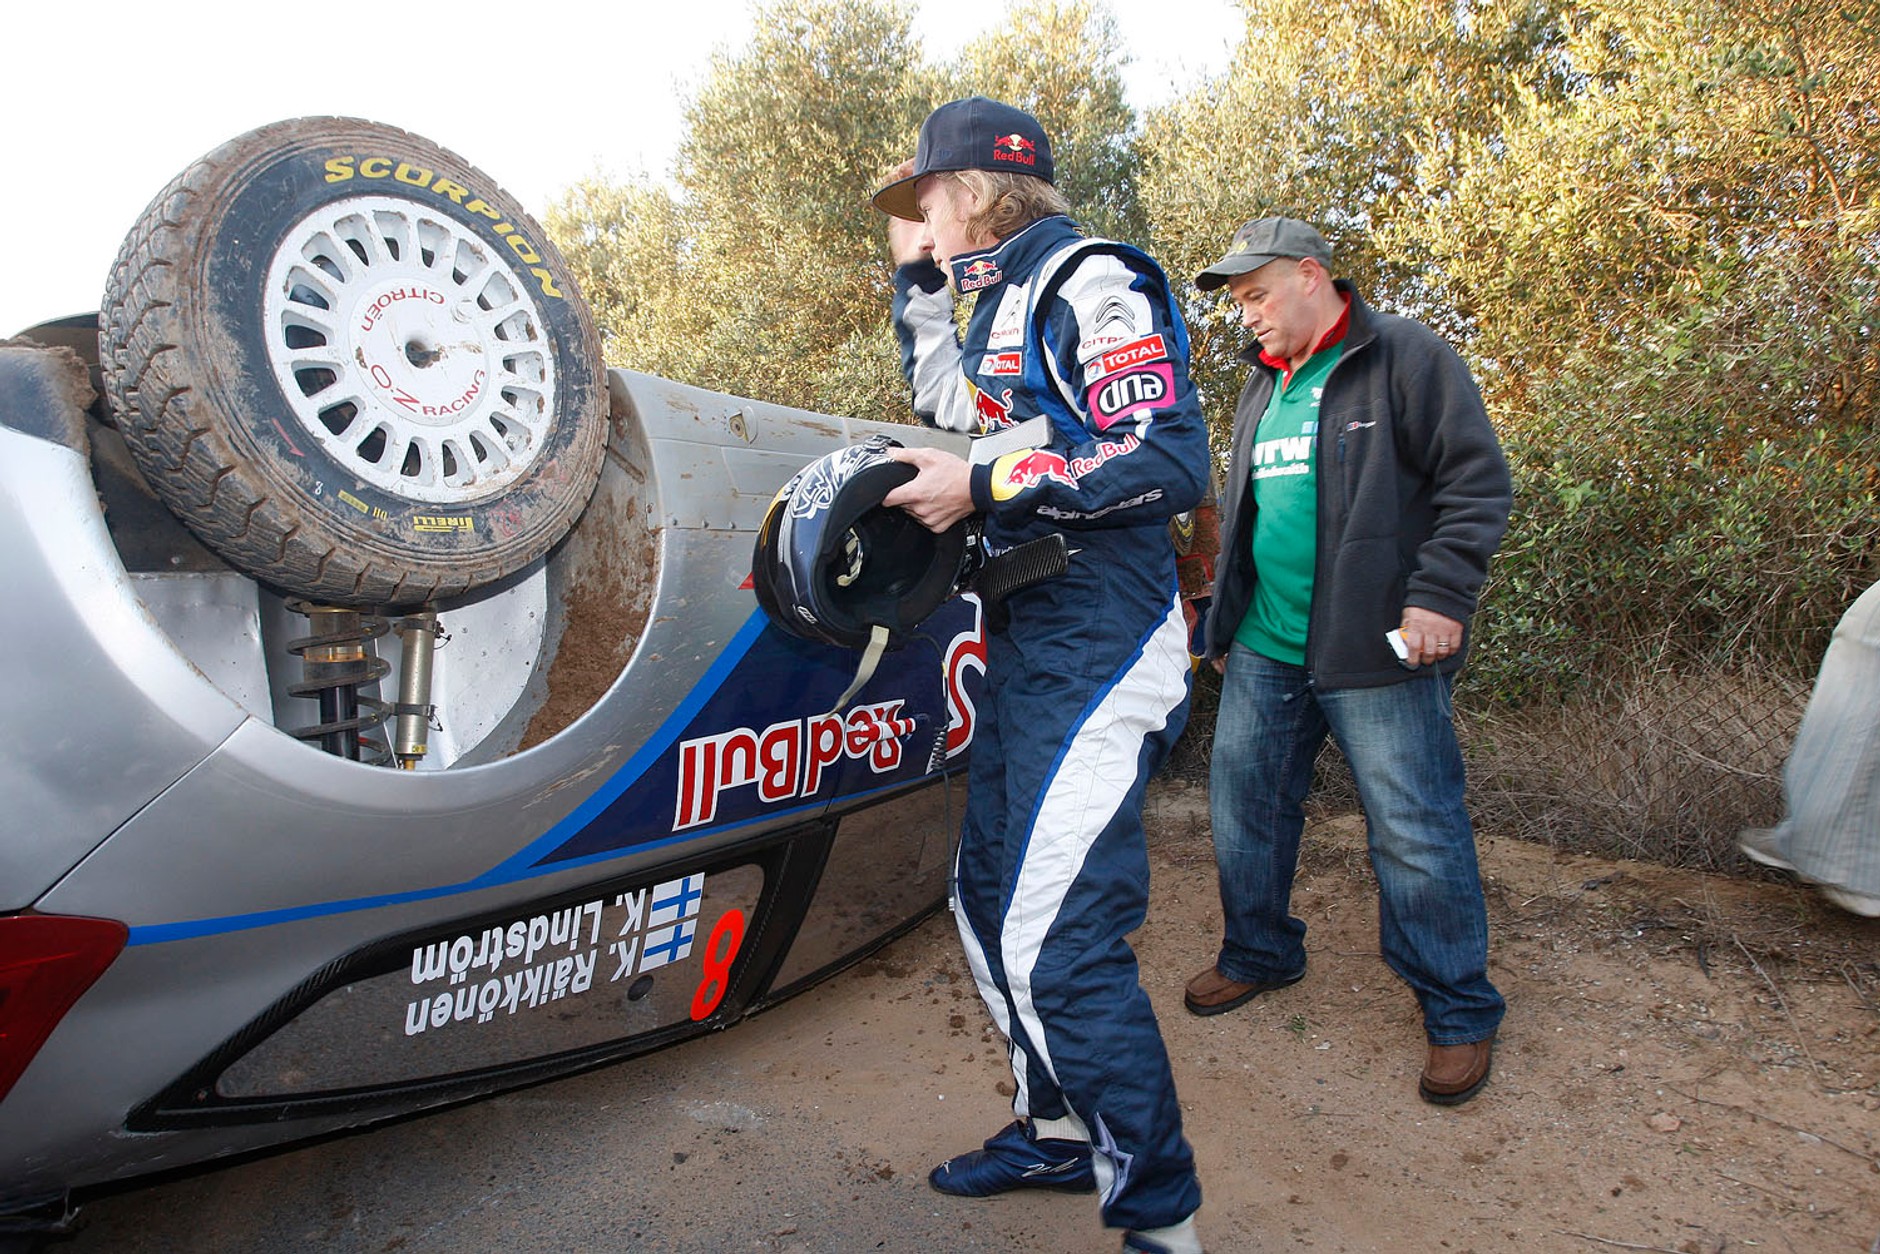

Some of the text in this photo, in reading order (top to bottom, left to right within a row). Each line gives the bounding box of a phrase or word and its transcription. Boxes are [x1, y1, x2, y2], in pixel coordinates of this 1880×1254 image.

[993, 149, 1036, 166] Red Bull
[325, 156, 563, 298] SCORPION
[961, 270, 1003, 292] Red Bull
[994, 359, 1020, 371] OTAL
[1104, 343, 1164, 368] TOTAL
[422, 369, 486, 416] RACING
[1099, 373, 1165, 414] dna
[1070, 433, 1141, 479] Red Bull
[413, 516, 474, 533] PIRELLI
[672, 699, 905, 832] Red Bull
[411, 888, 647, 985] K. Lindström
[404, 936, 639, 1036] K. Räikkönen
[690, 908, 745, 1022] 8
